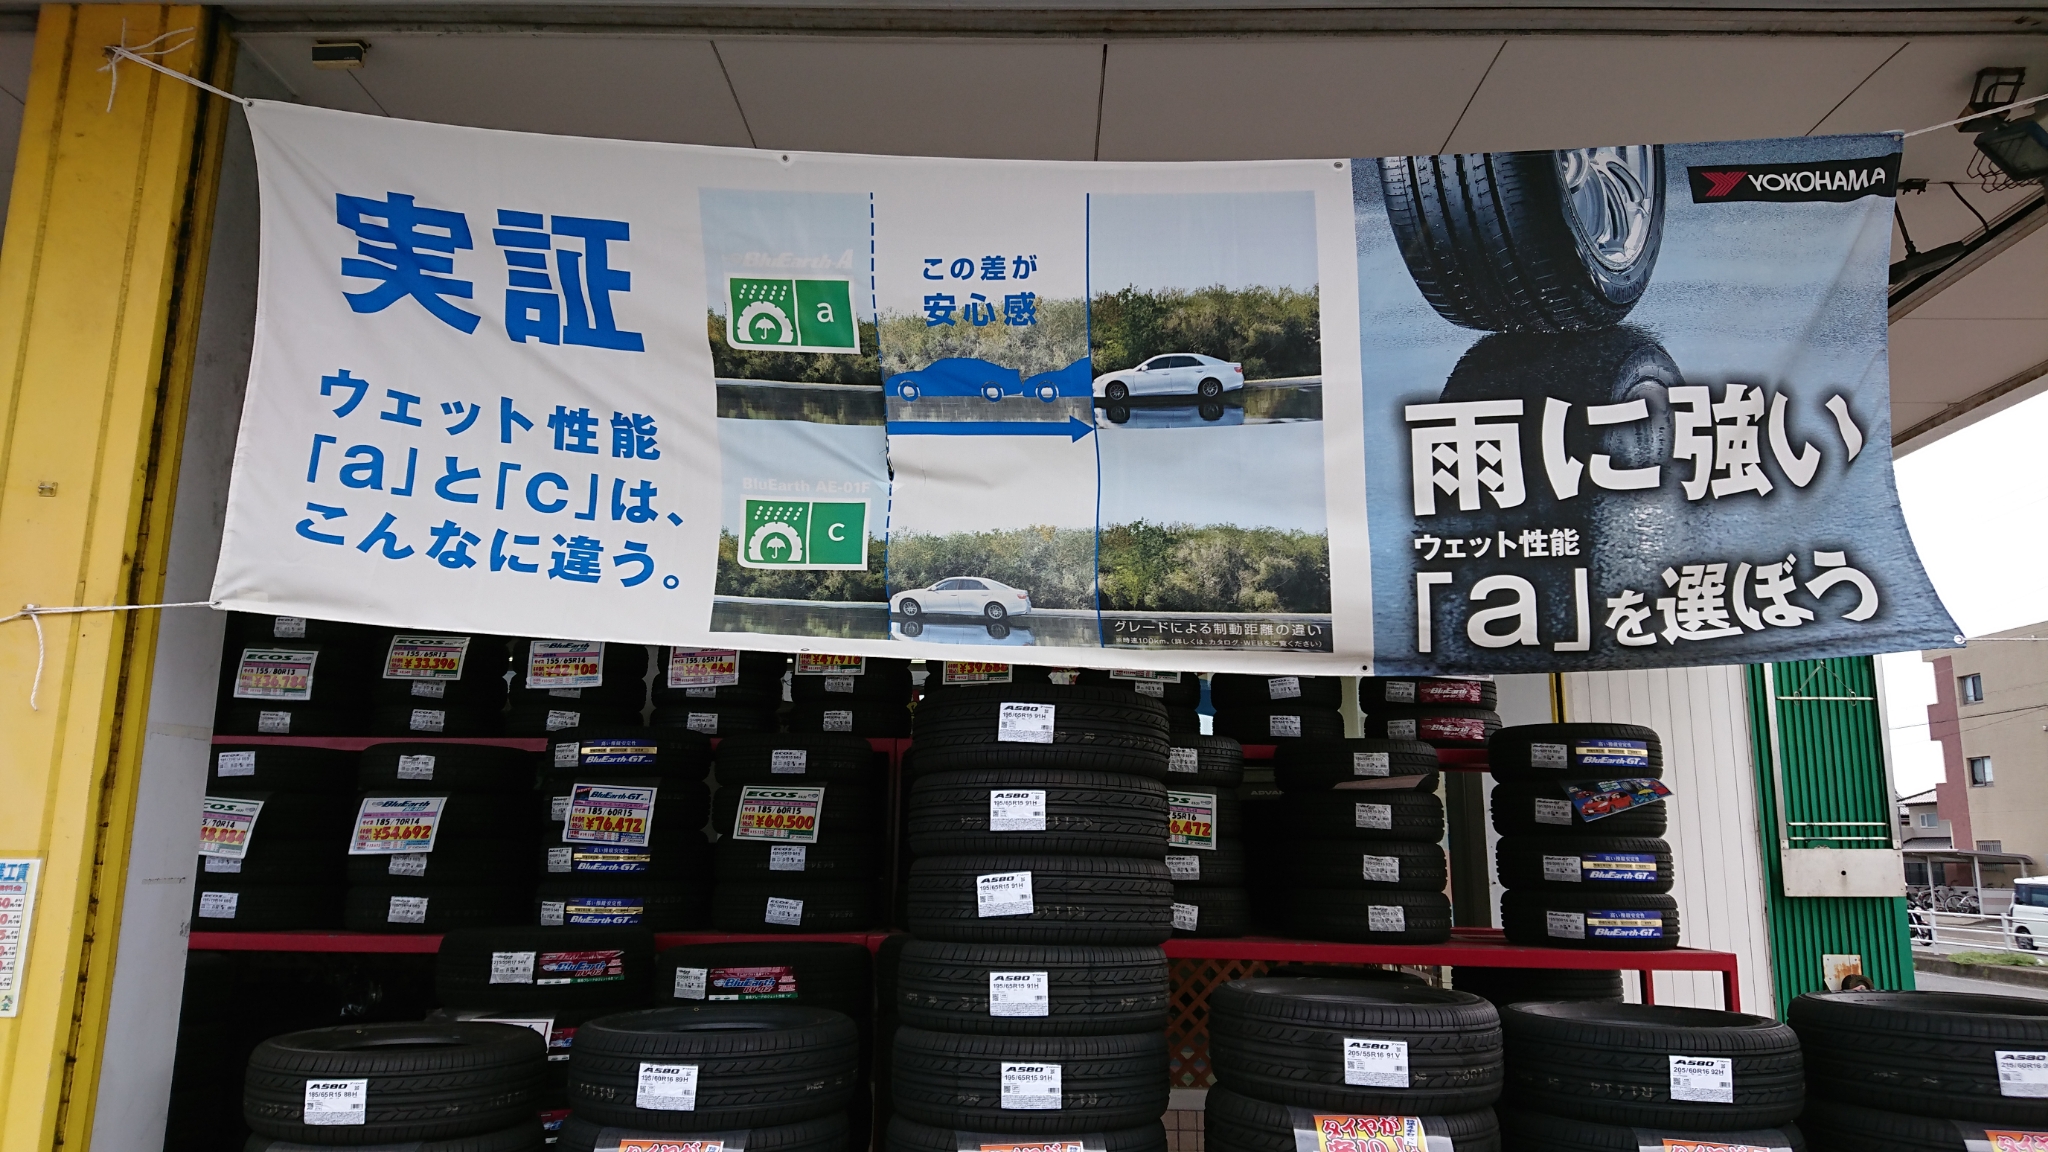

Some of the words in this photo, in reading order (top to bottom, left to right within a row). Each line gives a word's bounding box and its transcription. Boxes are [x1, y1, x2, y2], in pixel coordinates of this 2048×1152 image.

[1748, 166, 1887, 192] YOKOHAMA
[335, 191, 645, 353] 実証
[923, 254, 1037, 281] この差が
[816, 302, 835, 323] a
[923, 292, 1037, 327] 安心感
[320, 368, 661, 461] ウェット性能
[1404, 383, 1864, 517] 雨に強い
[295, 501, 680, 590] こんなに違う。
[1413, 527, 1581, 561] ウェット性能
[1414, 549, 1880, 653] 「a」を選ぼう
[1114, 620, 1323, 636] グレードによる制動距離の違い
[585, 755, 646, 764] BluEarth-GT
[1582, 756, 1641, 765] BluEarth-GT
[590, 791, 644, 800] BluEarth-GT
[204, 803, 237, 811] COS
[382, 800, 430, 808] BluEarth
[758, 805, 802, 814] 185/60R15
[588, 807, 633, 816] 185/60R15
[1590, 870, 1649, 879] BluEarth-GT
[570, 915, 631, 923] BluEarth-GT
[1594, 928, 1654, 936] BluEarth-GT
[555, 961, 607, 972] BluEarth
[723, 977, 777, 988] BluEarth
[1322, 1116, 1402, 1140] タイヤが
